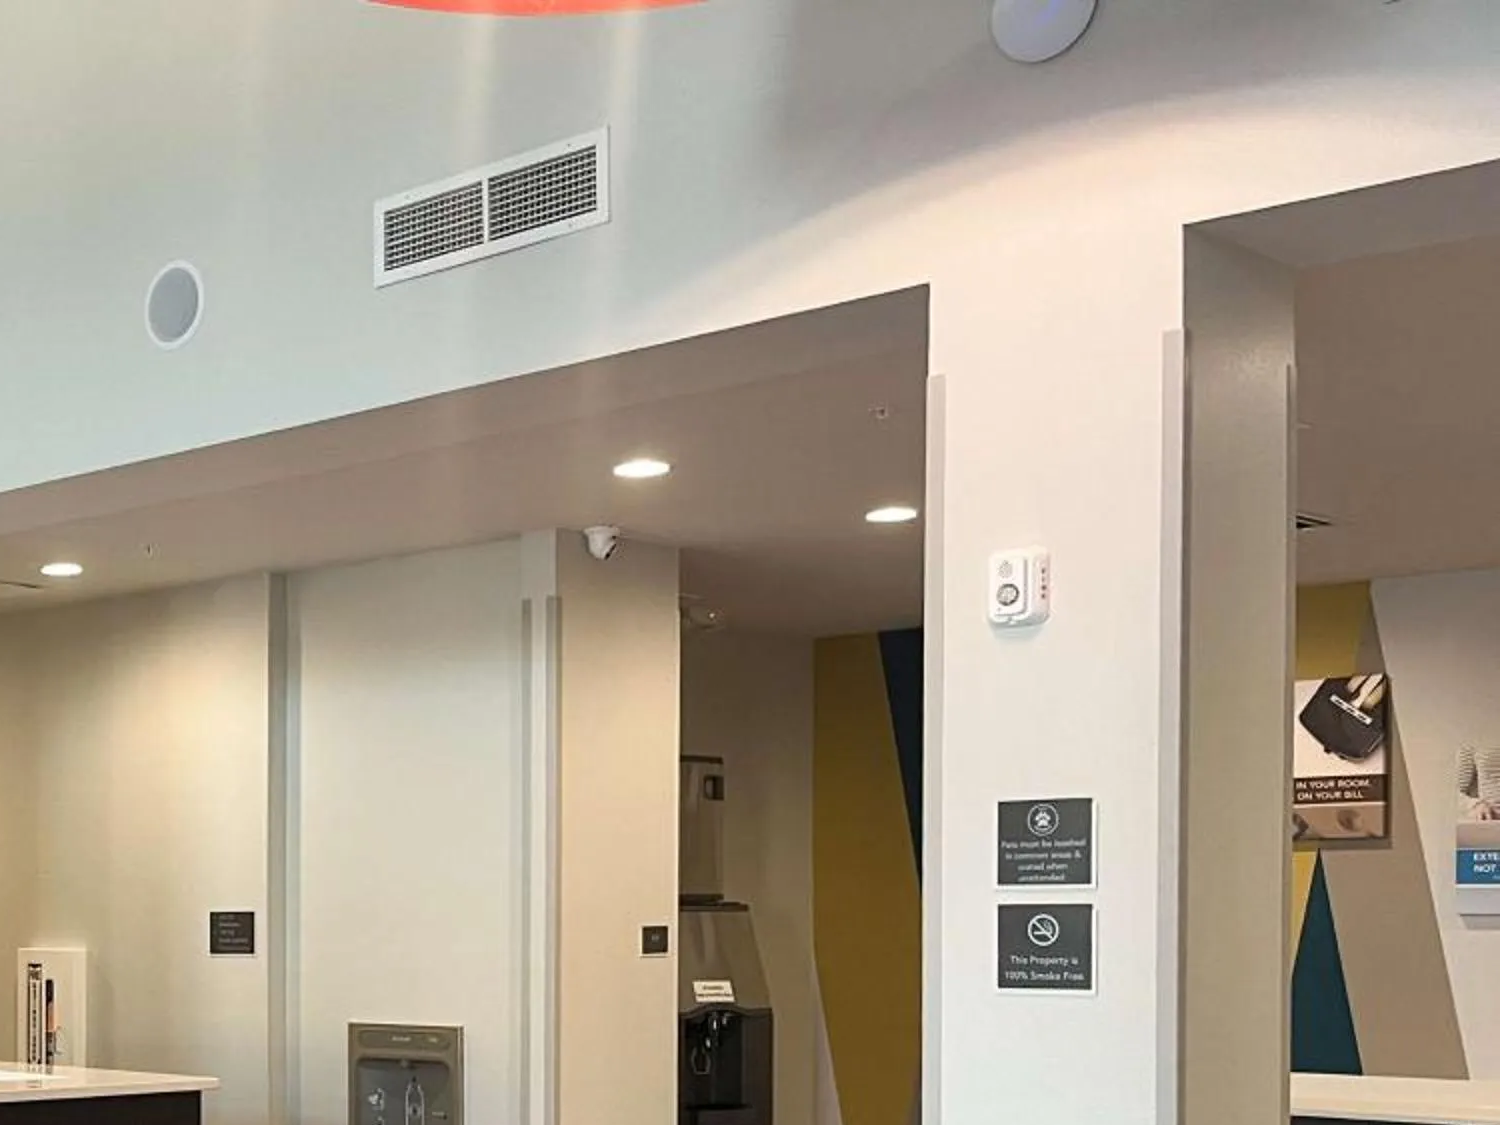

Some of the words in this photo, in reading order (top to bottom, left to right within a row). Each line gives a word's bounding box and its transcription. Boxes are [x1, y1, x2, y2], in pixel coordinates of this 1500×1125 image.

[1309, 780, 1335, 789] YOUR
[1297, 791, 1313, 801] ON
[1315, 791, 1342, 799] YOUR
[1473, 863, 1497, 873] NOT
[1010, 955, 1028, 965] This
[1030, 955, 1069, 967] Property
[1030, 970, 1061, 981] Smoke
